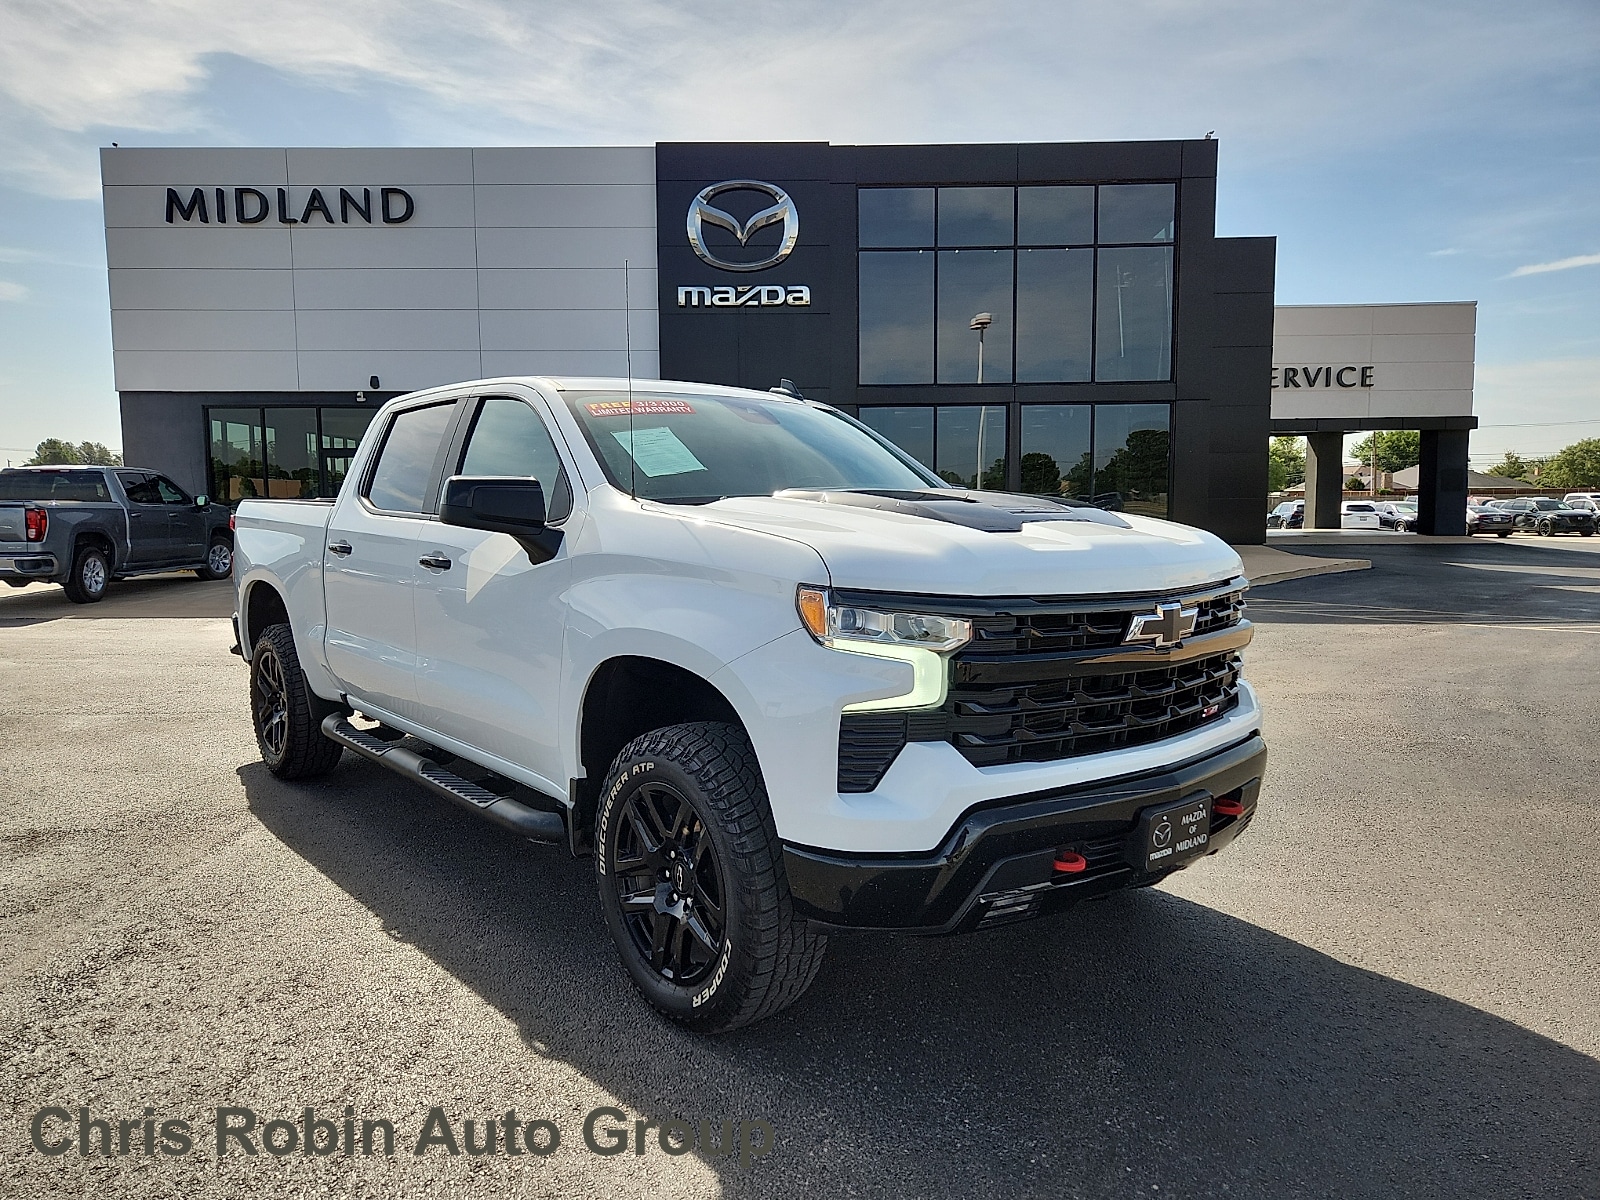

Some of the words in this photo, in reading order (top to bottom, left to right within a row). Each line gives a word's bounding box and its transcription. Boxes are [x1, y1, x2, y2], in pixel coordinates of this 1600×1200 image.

[165, 187, 415, 224] MIDLAND
[590, 401, 631, 410] FREE
[591, 408, 634, 416] LIMITED
[599, 771, 629, 876] DISCOVERER
[632, 762, 655, 776] ATP
[1181, 809, 1206, 826] MAZDA
[1188, 824, 1198, 834] OF
[1175, 833, 1207, 853] MIDLAND
[692, 938, 732, 1008] COOPER
